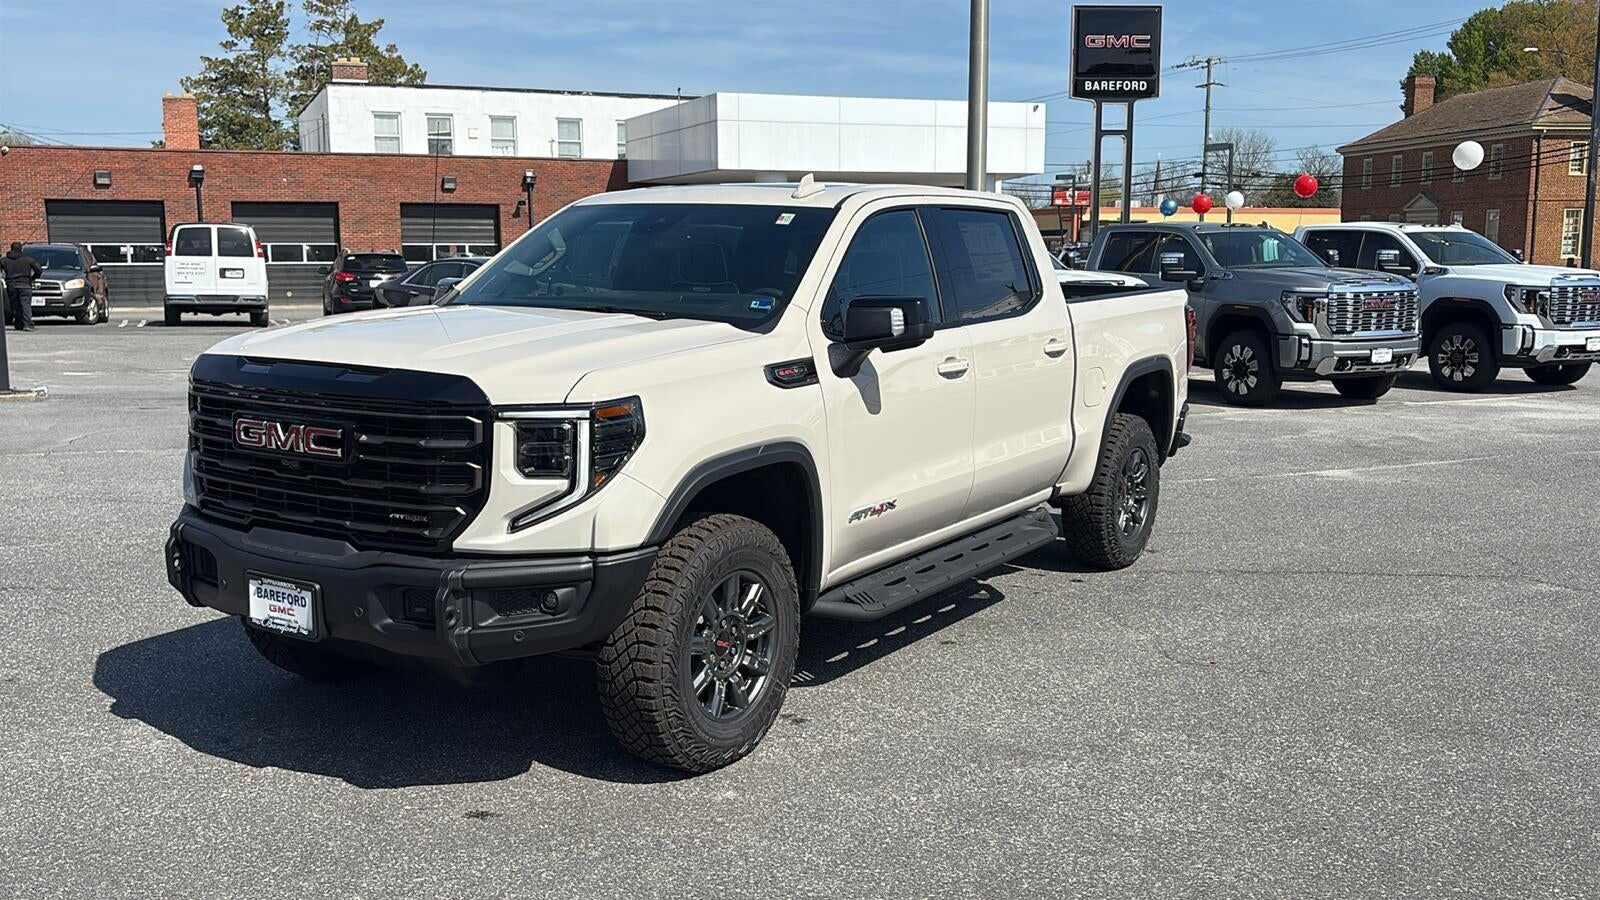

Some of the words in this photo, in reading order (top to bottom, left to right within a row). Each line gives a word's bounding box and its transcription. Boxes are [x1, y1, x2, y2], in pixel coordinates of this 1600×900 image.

[1085, 34, 1151, 48] GMC
[1084, 80, 1147, 91] BAREFORD
[1364, 298, 1397, 309] GMC
[235, 418, 342, 457] GMC
[848, 498, 898, 524] AT4X
[256, 587, 306, 608] BAREFORD
[269, 604, 295, 616] GMC
